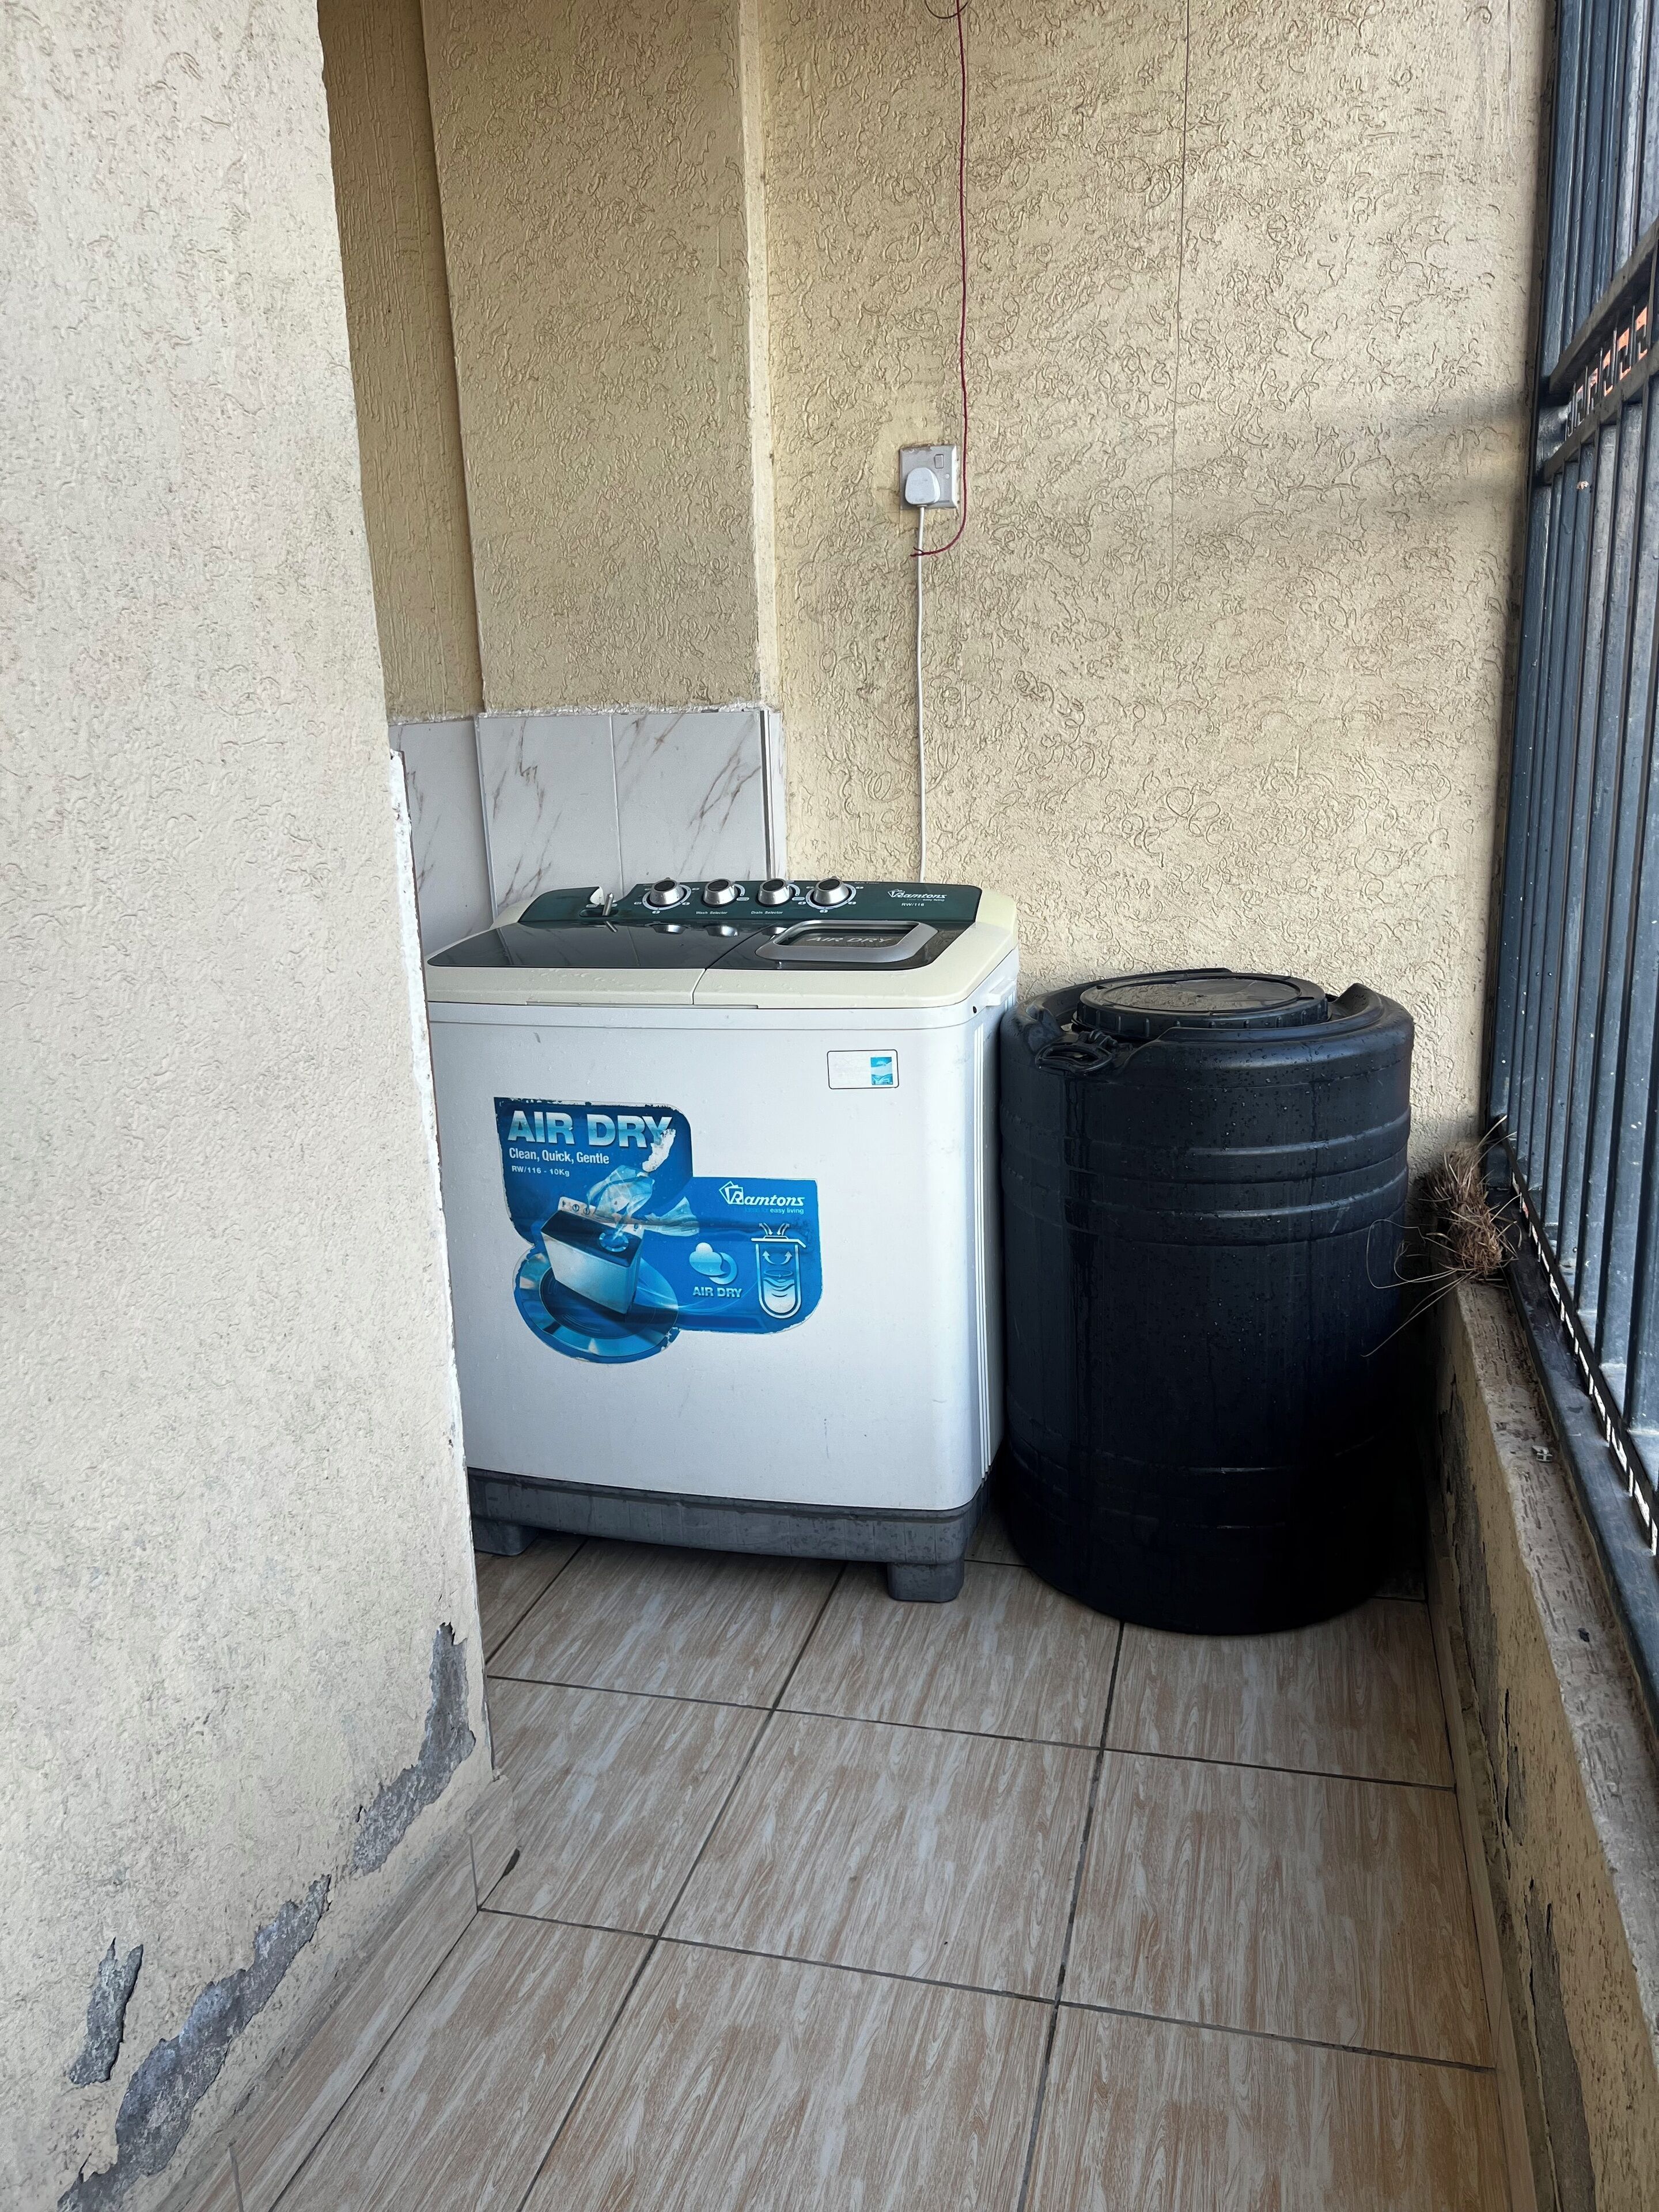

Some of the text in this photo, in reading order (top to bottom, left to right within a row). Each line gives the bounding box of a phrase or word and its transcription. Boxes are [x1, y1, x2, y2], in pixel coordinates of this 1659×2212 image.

[892, 891, 948, 899] Ramtons
[507, 1110, 673, 1148] AIR DRY
[509, 1147, 610, 1165] Clean, Quick, Gentle
[512, 1165, 541, 1174] RW/116
[550, 1168, 570, 1177] 10Kg
[729, 1188, 805, 1207] Ramtons
[786, 1207, 805, 1215] living
[692, 1286, 743, 1298] AIR DRY
